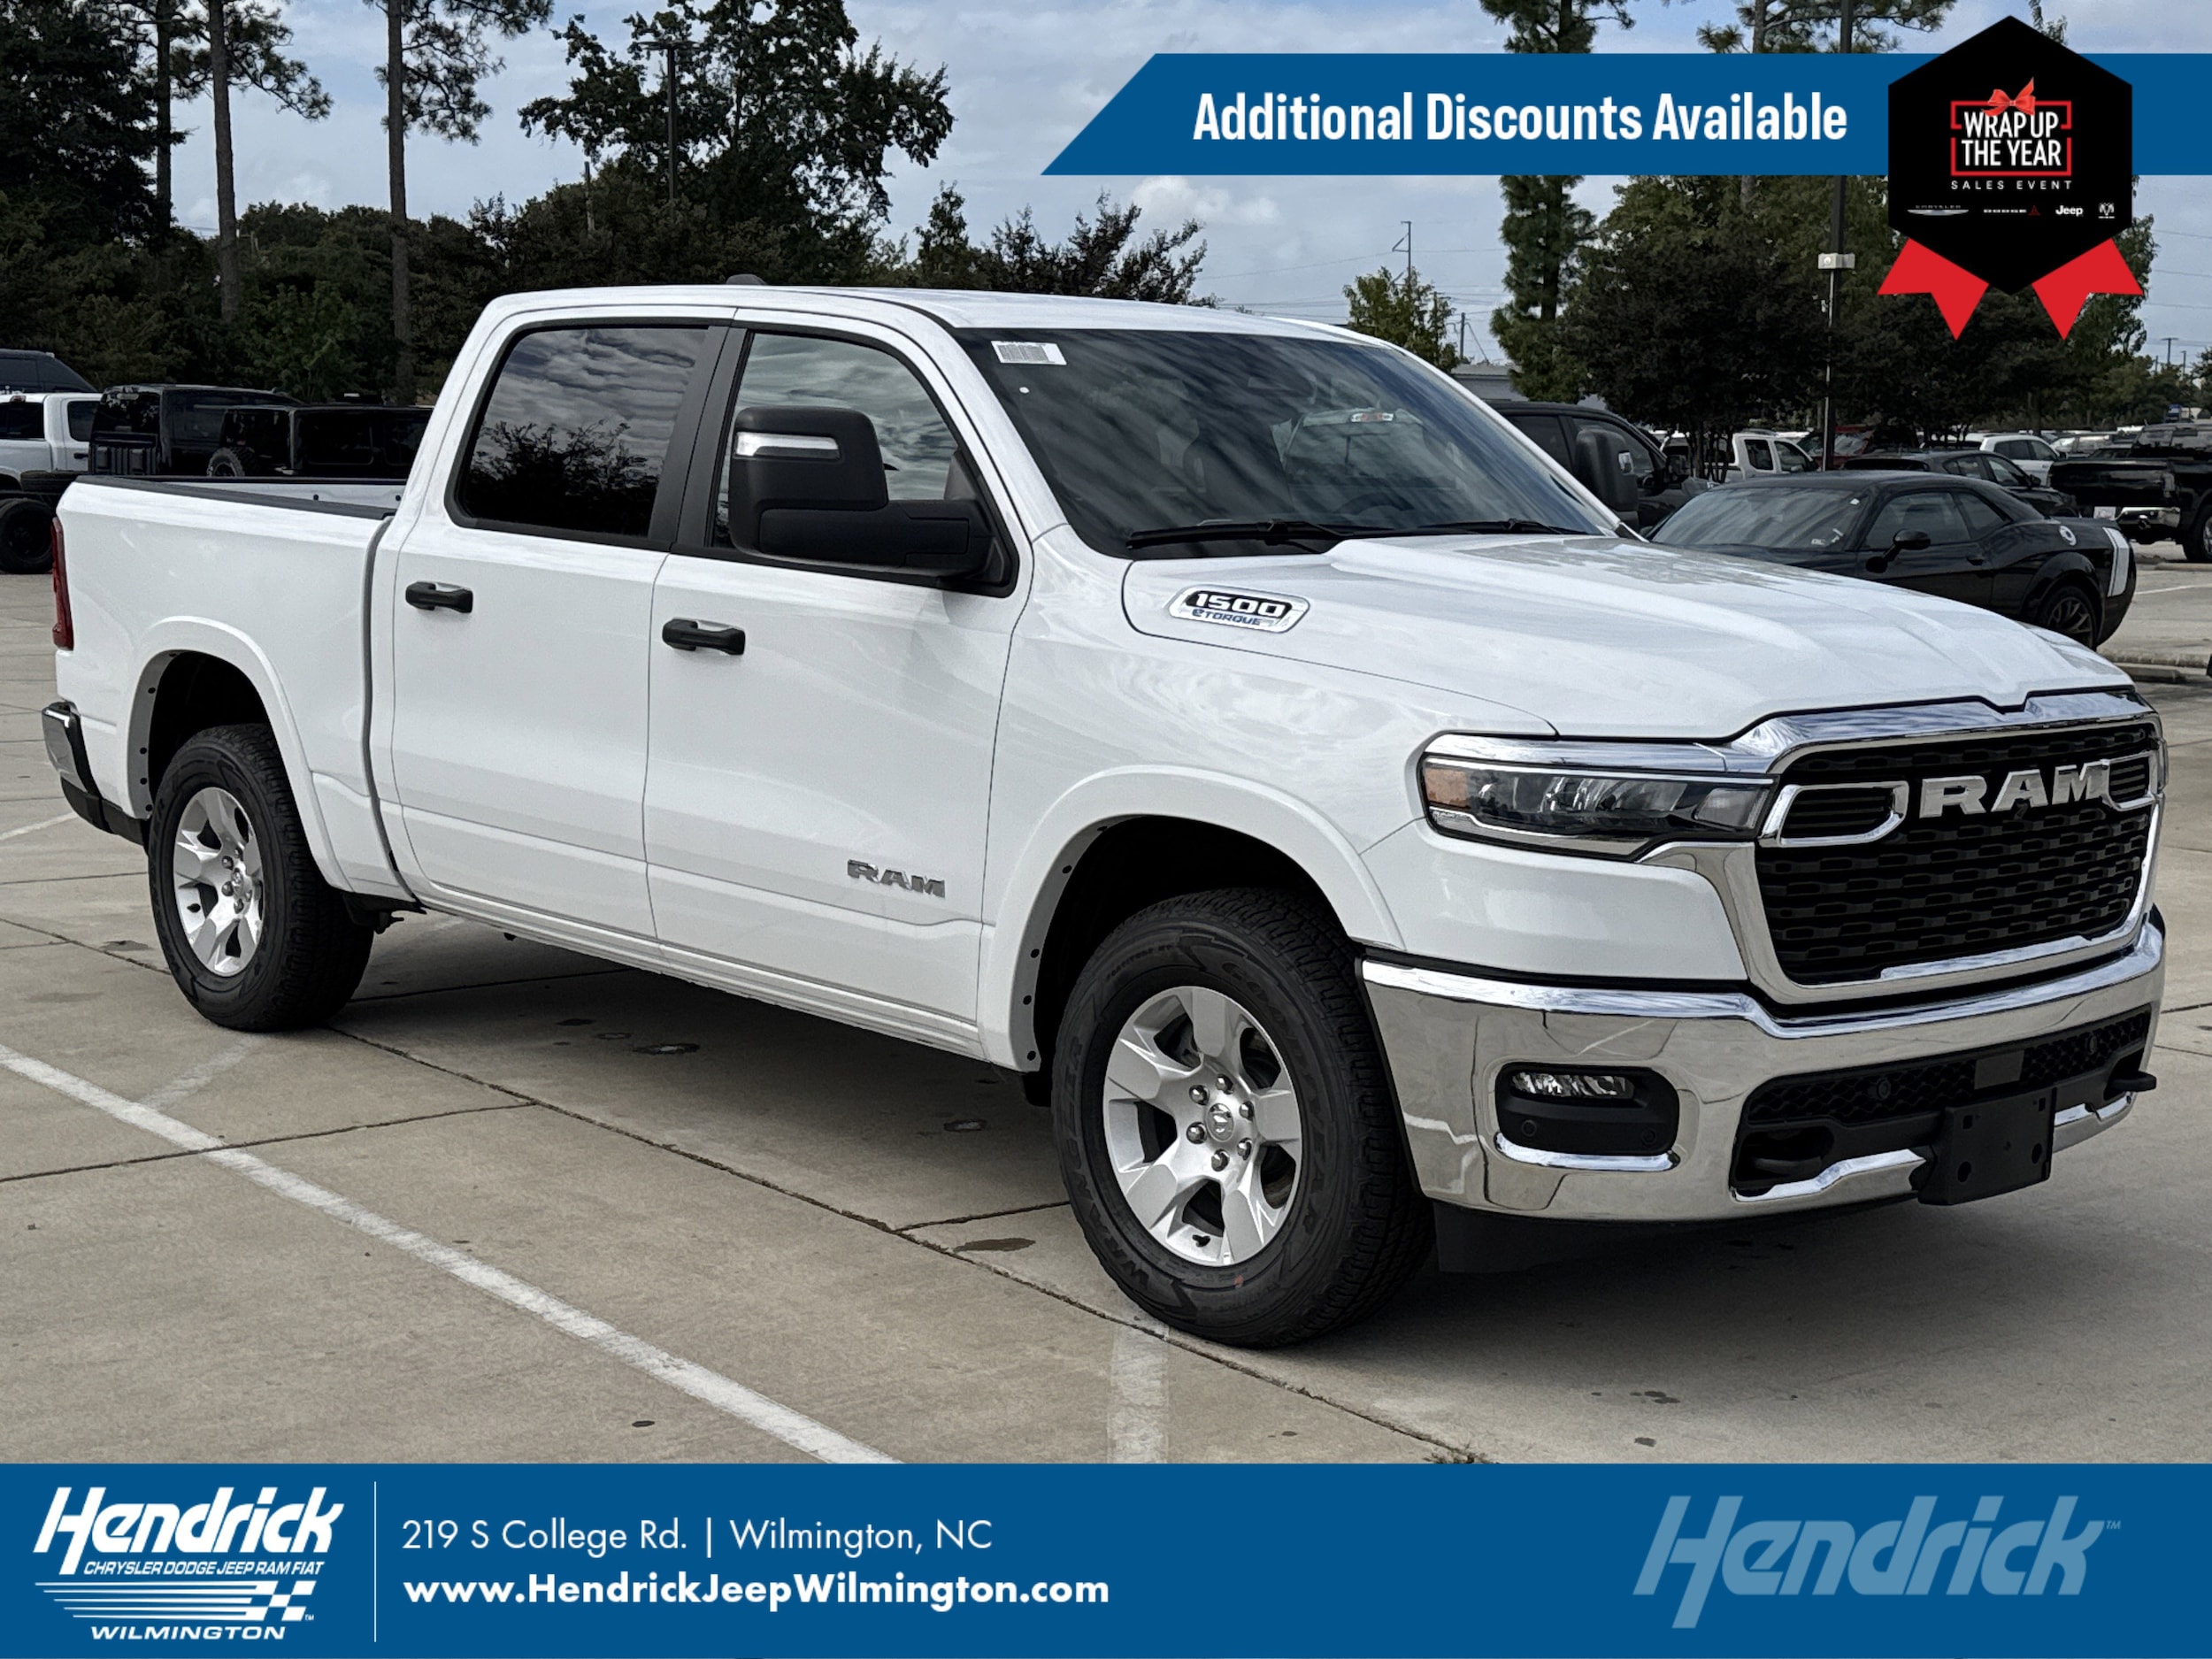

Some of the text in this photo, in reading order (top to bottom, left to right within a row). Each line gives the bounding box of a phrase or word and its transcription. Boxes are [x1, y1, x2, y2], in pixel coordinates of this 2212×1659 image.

[1194, 593, 1286, 618] 1500
[1919, 761, 2109, 818] RAM
[847, 859, 946, 899] RAM
